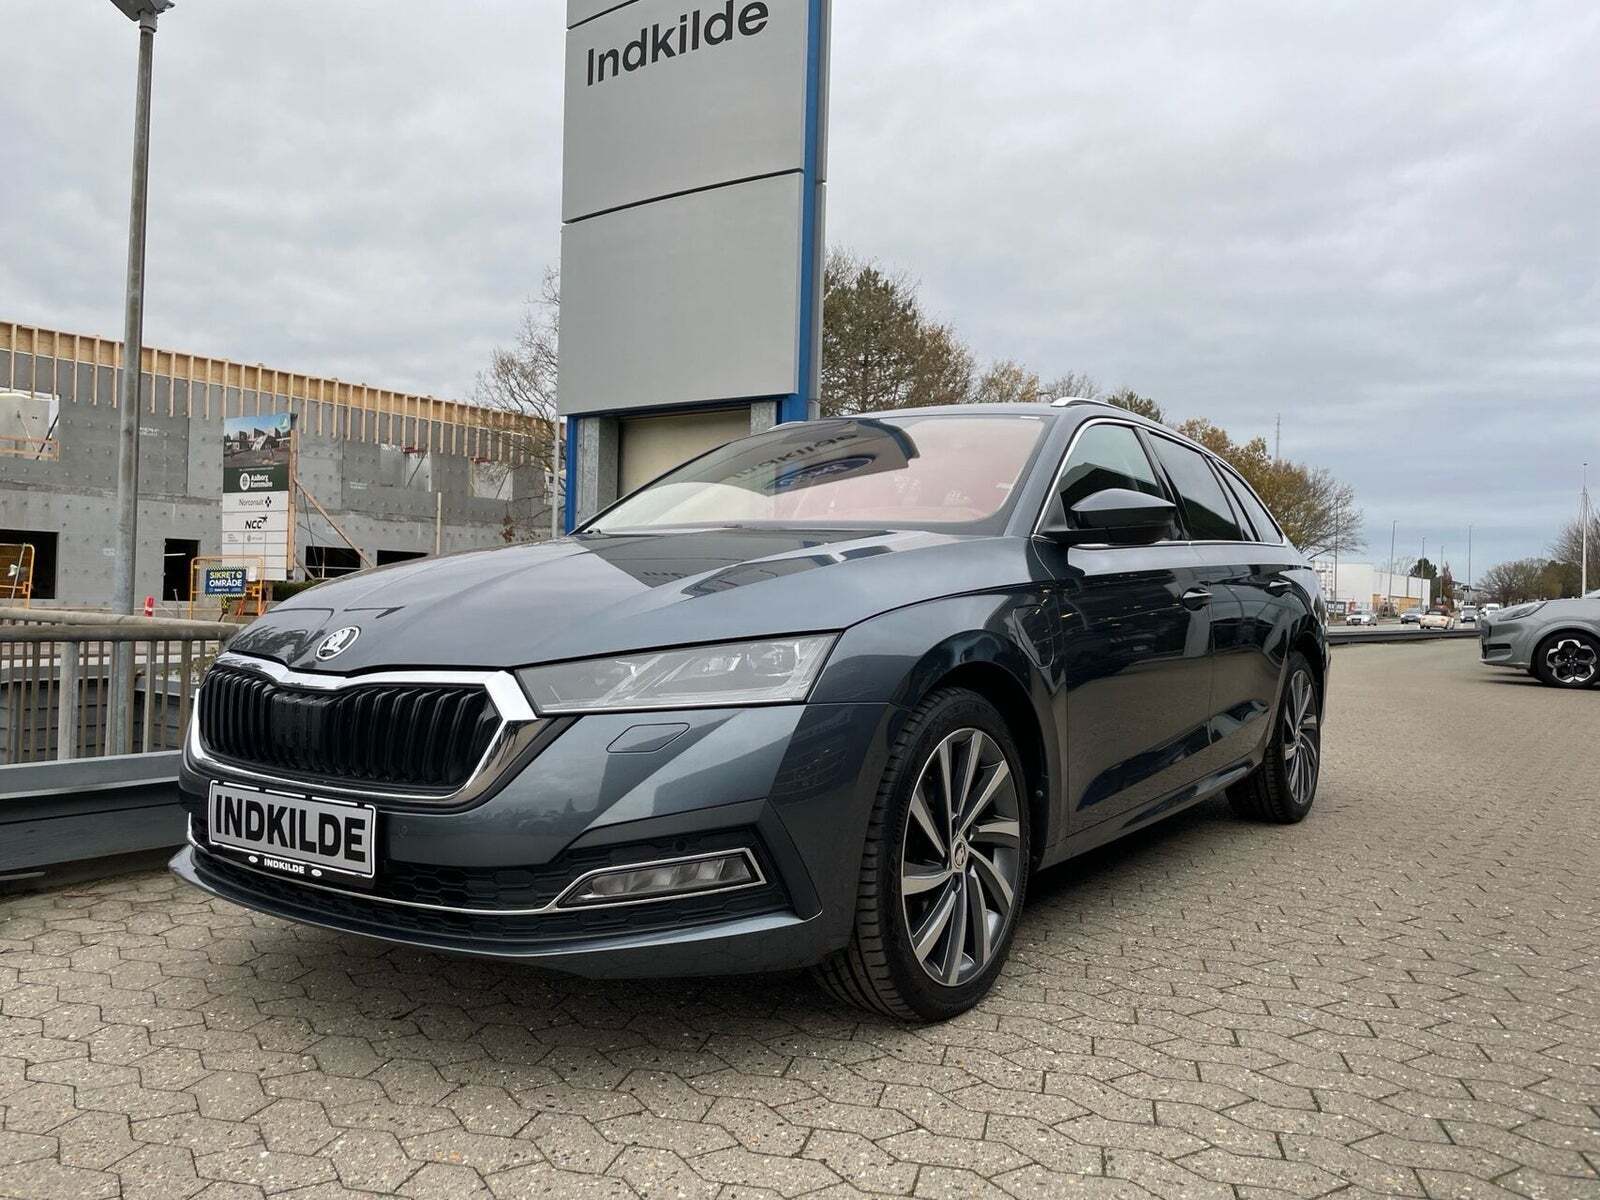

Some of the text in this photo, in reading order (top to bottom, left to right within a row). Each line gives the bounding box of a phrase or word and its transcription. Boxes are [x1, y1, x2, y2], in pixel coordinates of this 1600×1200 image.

[587, 0, 769, 86] Indkilde
[245, 520, 263, 529] NCC
[209, 571, 236, 579] SIKRET
[209, 577, 242, 587] OMRÅDE
[215, 794, 366, 863] INDKILDE
[263, 857, 305, 874] INDKILDE
